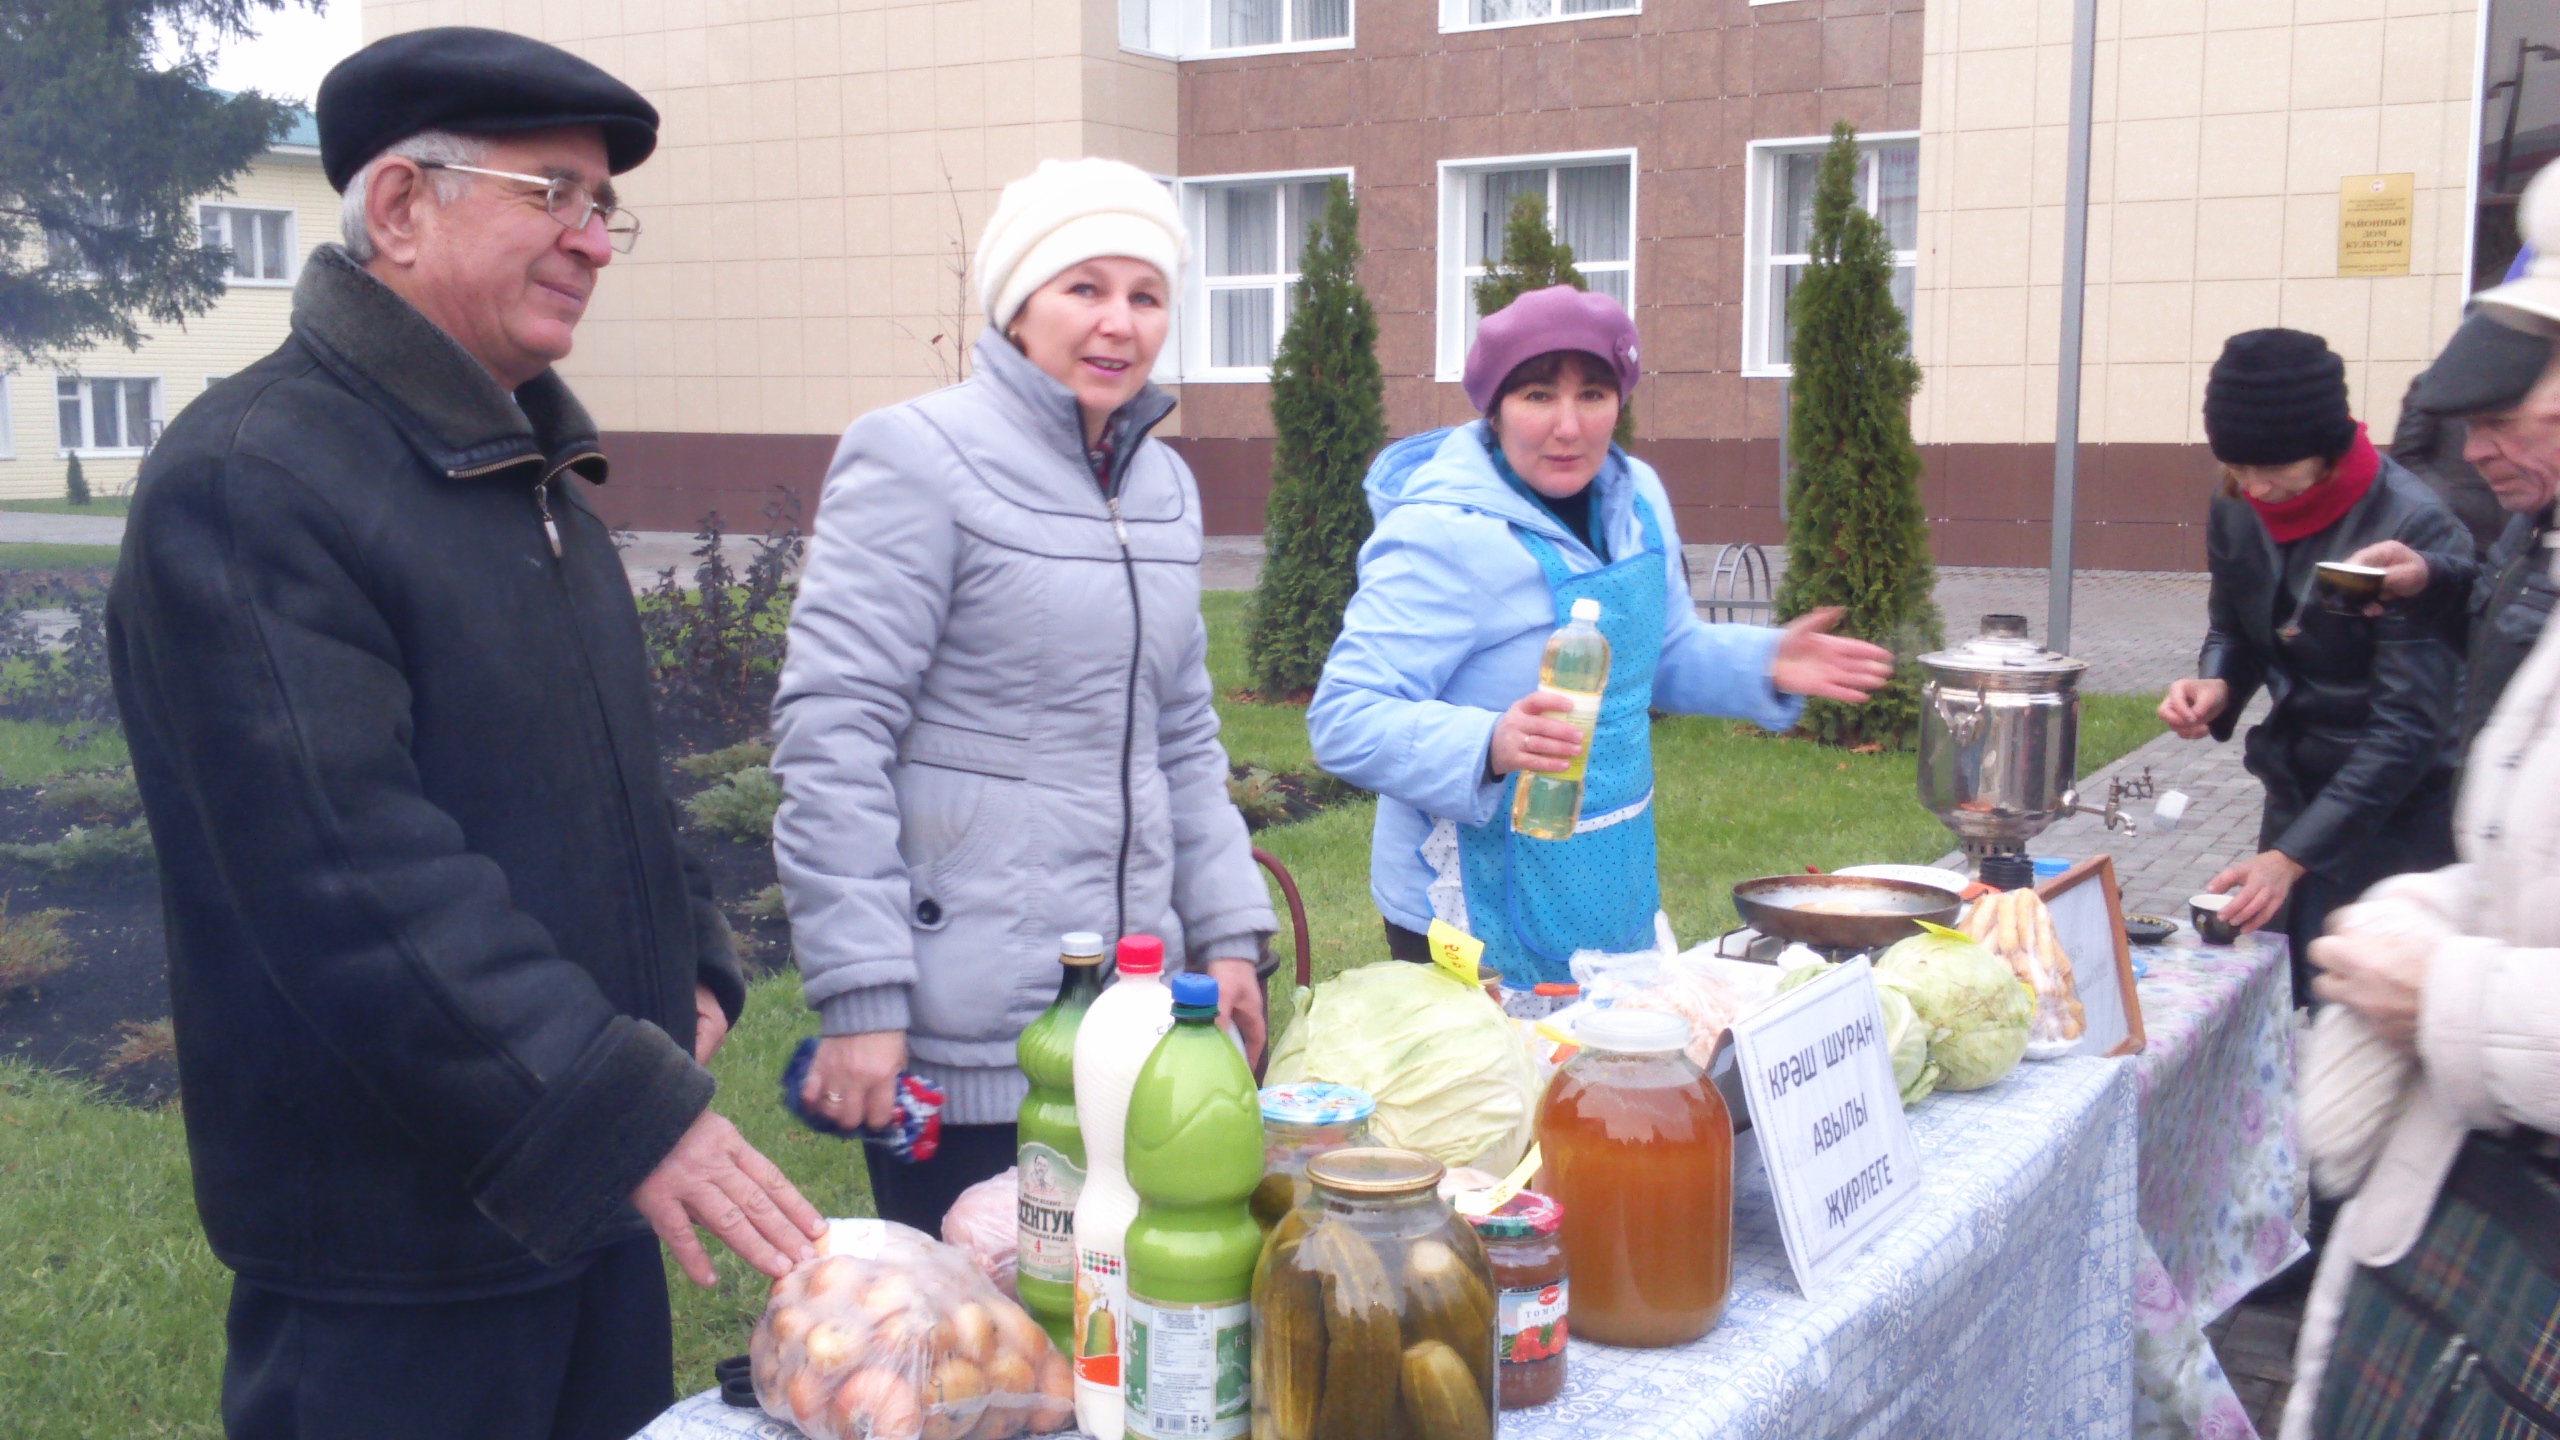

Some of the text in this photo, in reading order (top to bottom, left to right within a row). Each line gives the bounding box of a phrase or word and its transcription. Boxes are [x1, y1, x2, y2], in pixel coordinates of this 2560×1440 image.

[2344, 217, 2407, 228] РАЙОННЫЙ
[2363, 230, 2387, 238] ДОМ
[2345, 240, 2403, 249] КУЛЬТУРЫ
[1767, 1012, 1875, 1101] КРӘШ ШУРАН
[1814, 1091, 1869, 1157] АВЫЛЫ
[1018, 1197, 1074, 1235] СЕНТУК
[1035, 1239, 1042, 1253] 4
